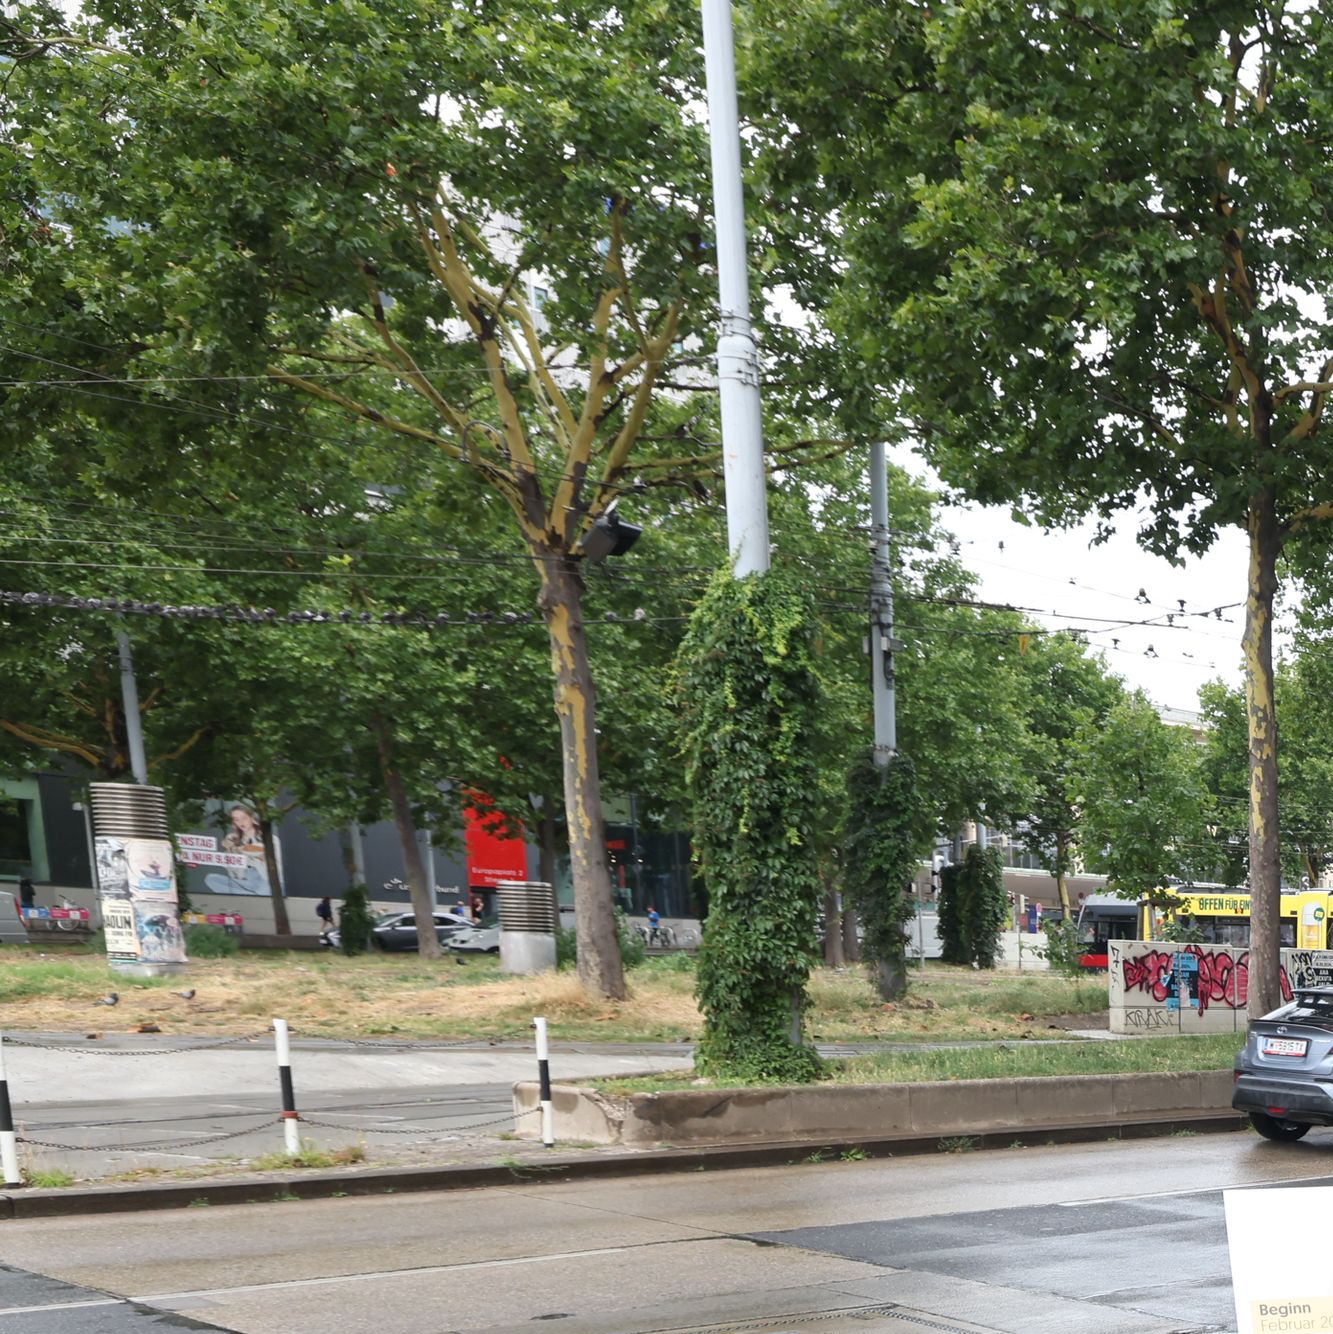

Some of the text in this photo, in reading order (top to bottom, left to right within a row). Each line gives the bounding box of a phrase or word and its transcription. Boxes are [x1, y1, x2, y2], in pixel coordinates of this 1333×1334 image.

[191, 852, 212, 863] NUR
[1198, 898, 1224, 911] OFFEN
[1225, 897, 1239, 911] FÜR
[1258, 1302, 1312, 1318] Beginn
[1260, 1317, 1317, 1332] Februar
